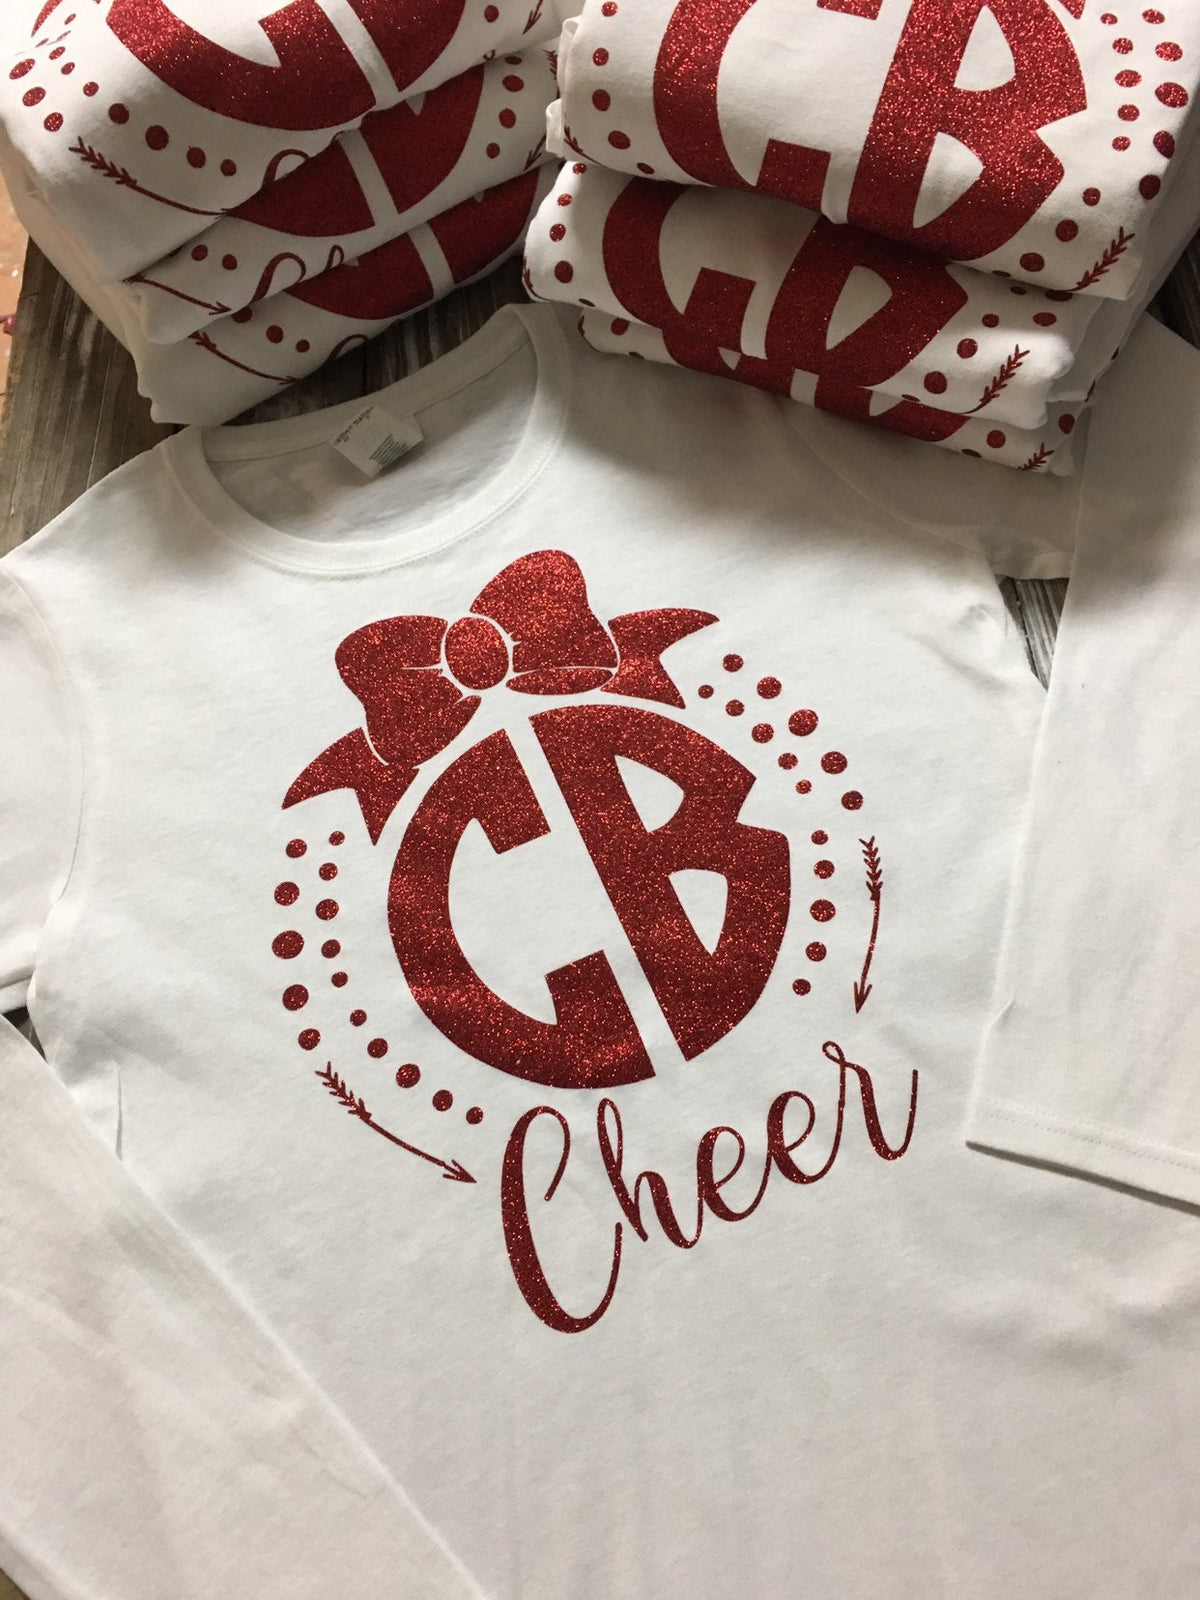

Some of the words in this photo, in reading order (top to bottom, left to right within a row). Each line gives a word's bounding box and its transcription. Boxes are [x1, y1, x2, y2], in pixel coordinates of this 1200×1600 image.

[653, 0, 1088, 261] CB
[386, 703, 791, 1090] CB
[501, 1040, 918, 1334] Cheer
